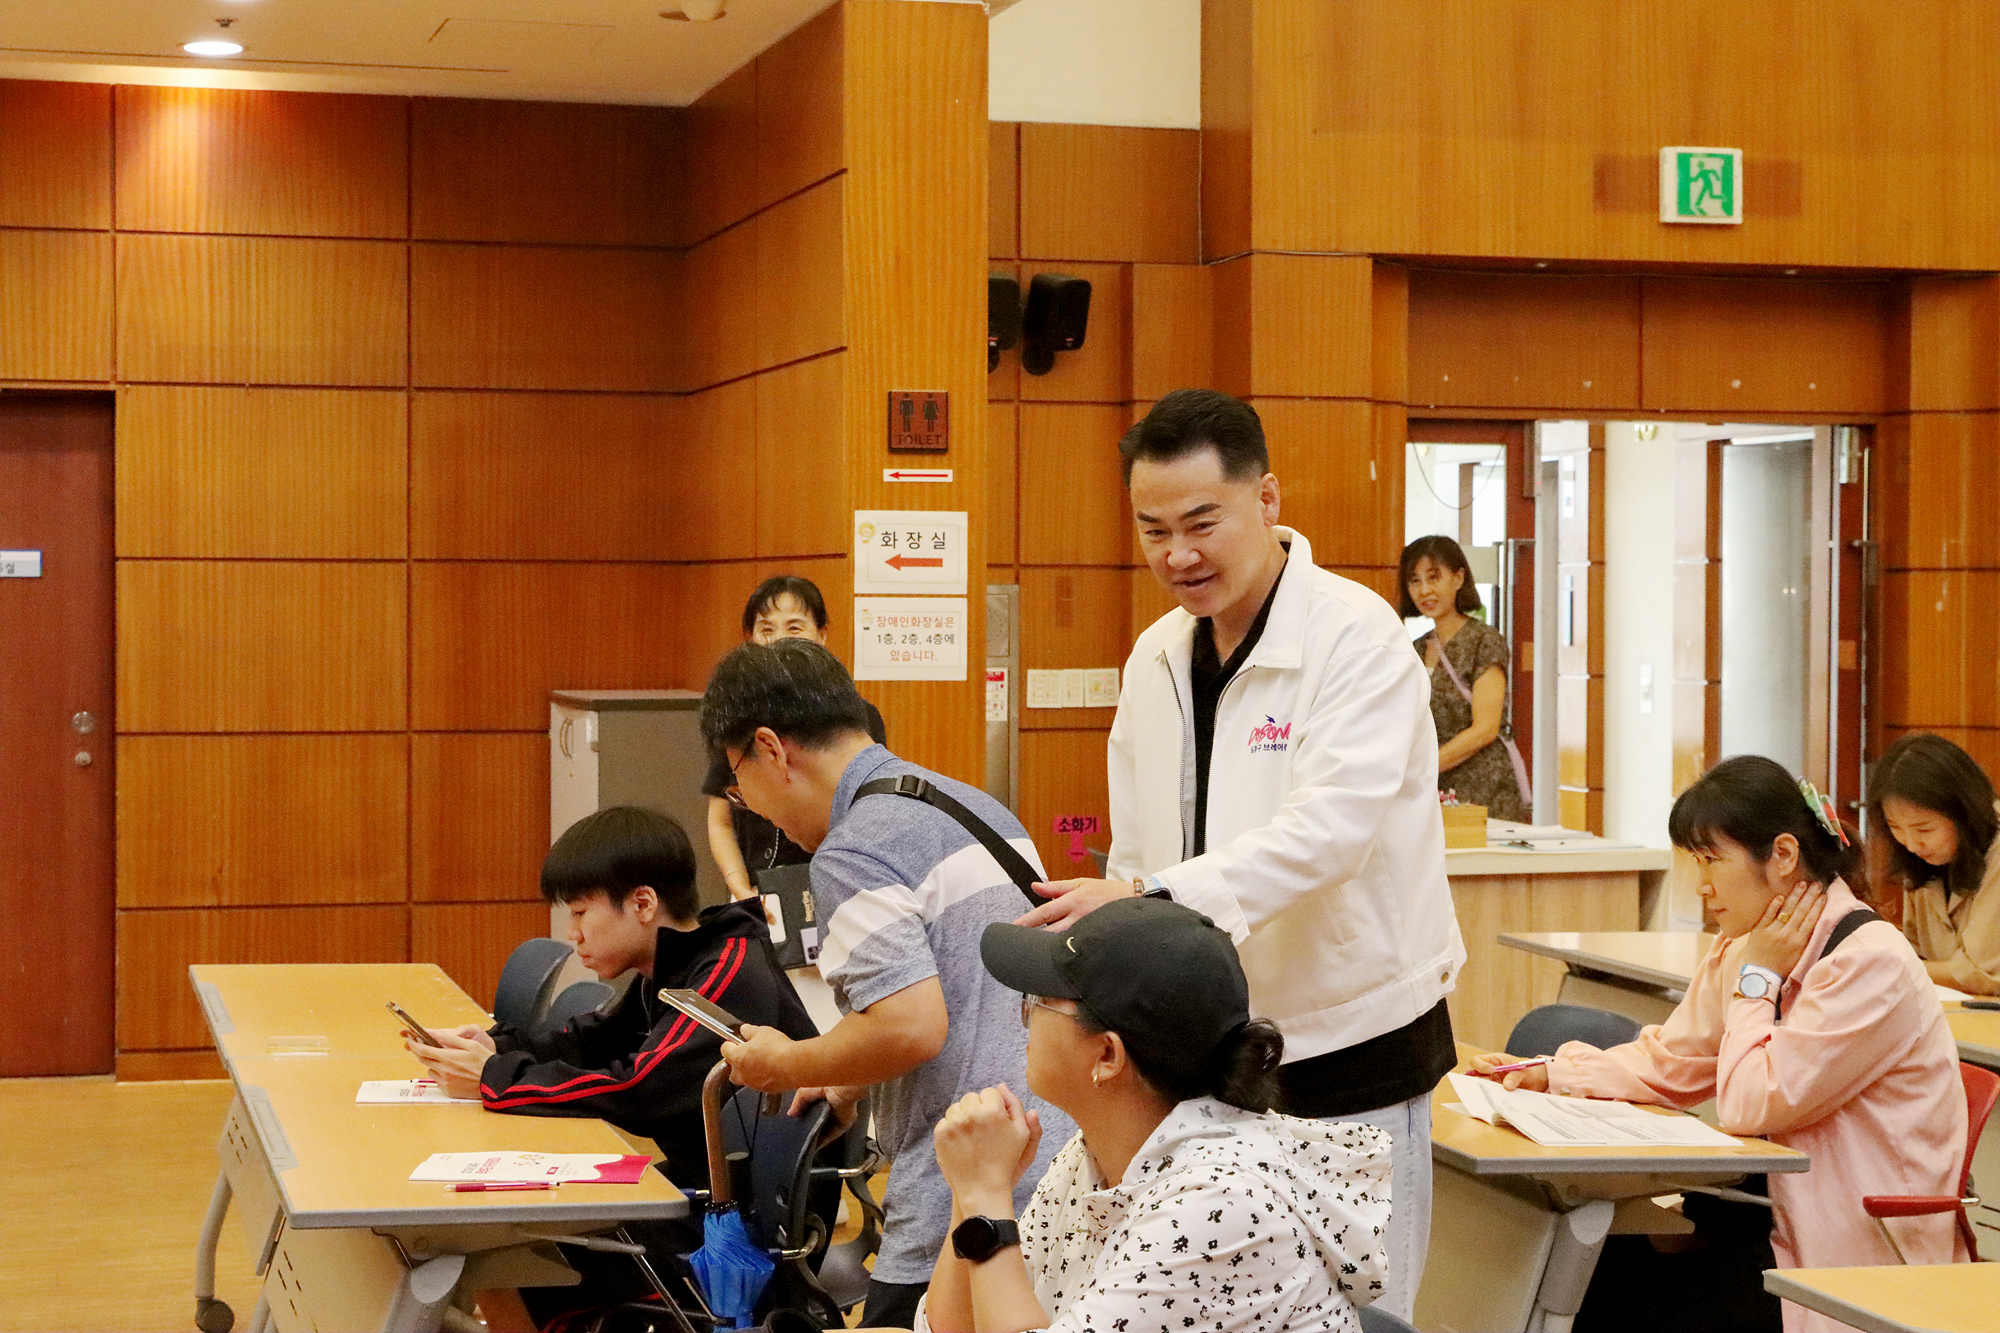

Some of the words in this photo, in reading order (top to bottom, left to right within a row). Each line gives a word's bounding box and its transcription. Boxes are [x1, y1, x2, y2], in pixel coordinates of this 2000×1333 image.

[896, 434, 943, 446] TOILET
[876, 616, 956, 629] 장애인화장실은
[877, 633, 897, 646] 1층,
[901, 634, 922, 646] 2층,
[926, 633, 955, 646] 4층에
[889, 650, 939, 662] 있습니다.
[1058, 817, 1097, 833] 소화기
